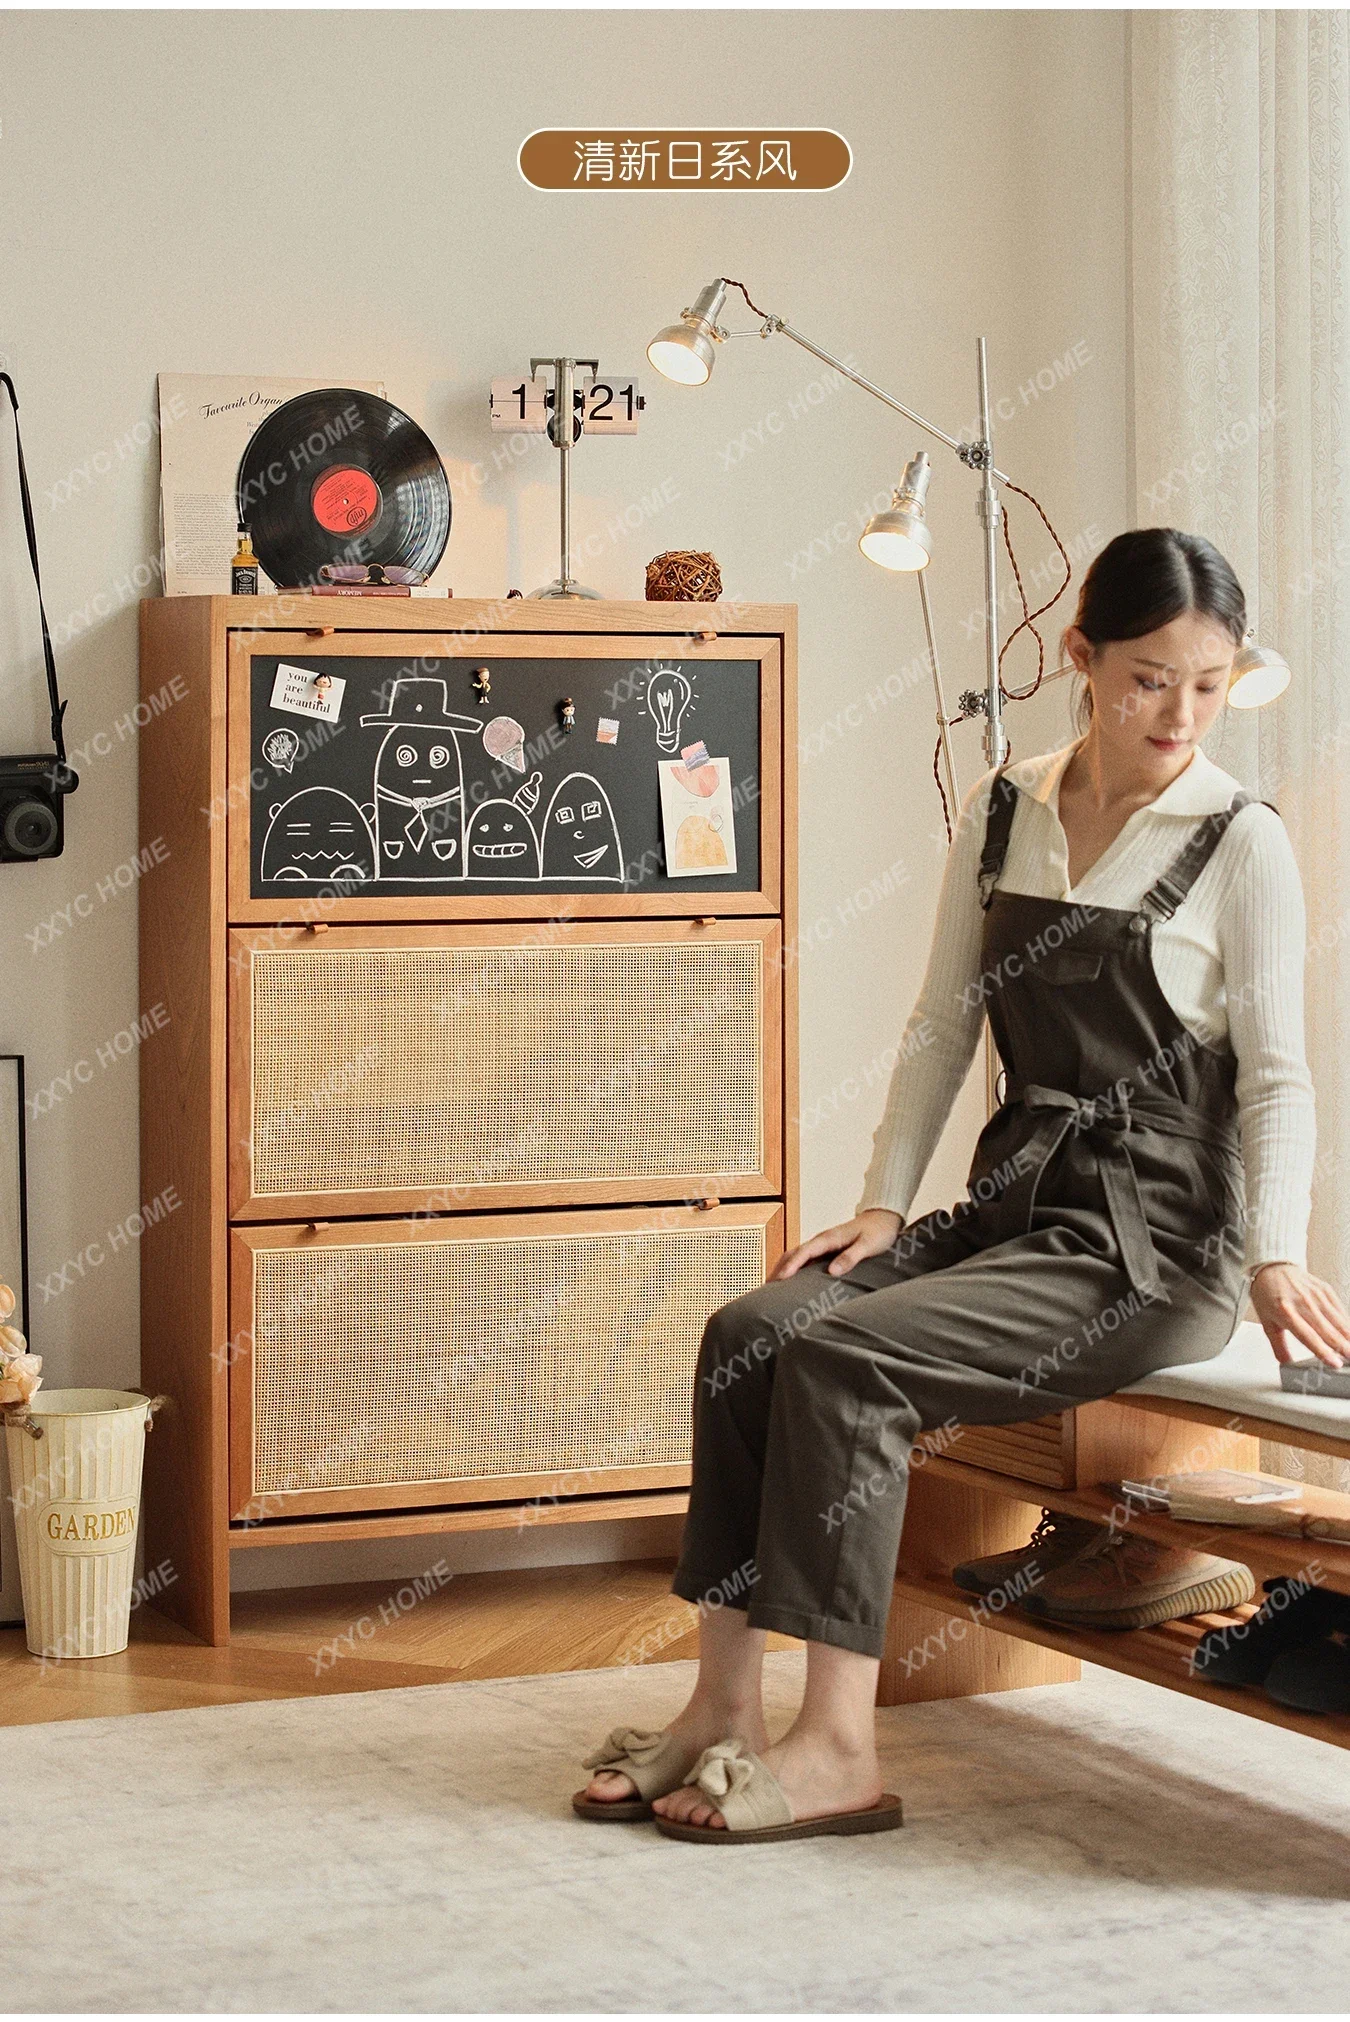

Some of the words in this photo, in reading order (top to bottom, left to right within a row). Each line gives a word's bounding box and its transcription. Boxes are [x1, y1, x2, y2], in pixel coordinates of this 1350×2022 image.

[512, 383, 526, 420] 1
[589, 384, 633, 421] 21
[286, 672, 308, 684] you
[285, 684, 304, 695] are
[282, 693, 331, 713] beautiful
[47, 1505, 136, 1541] GARDEN
